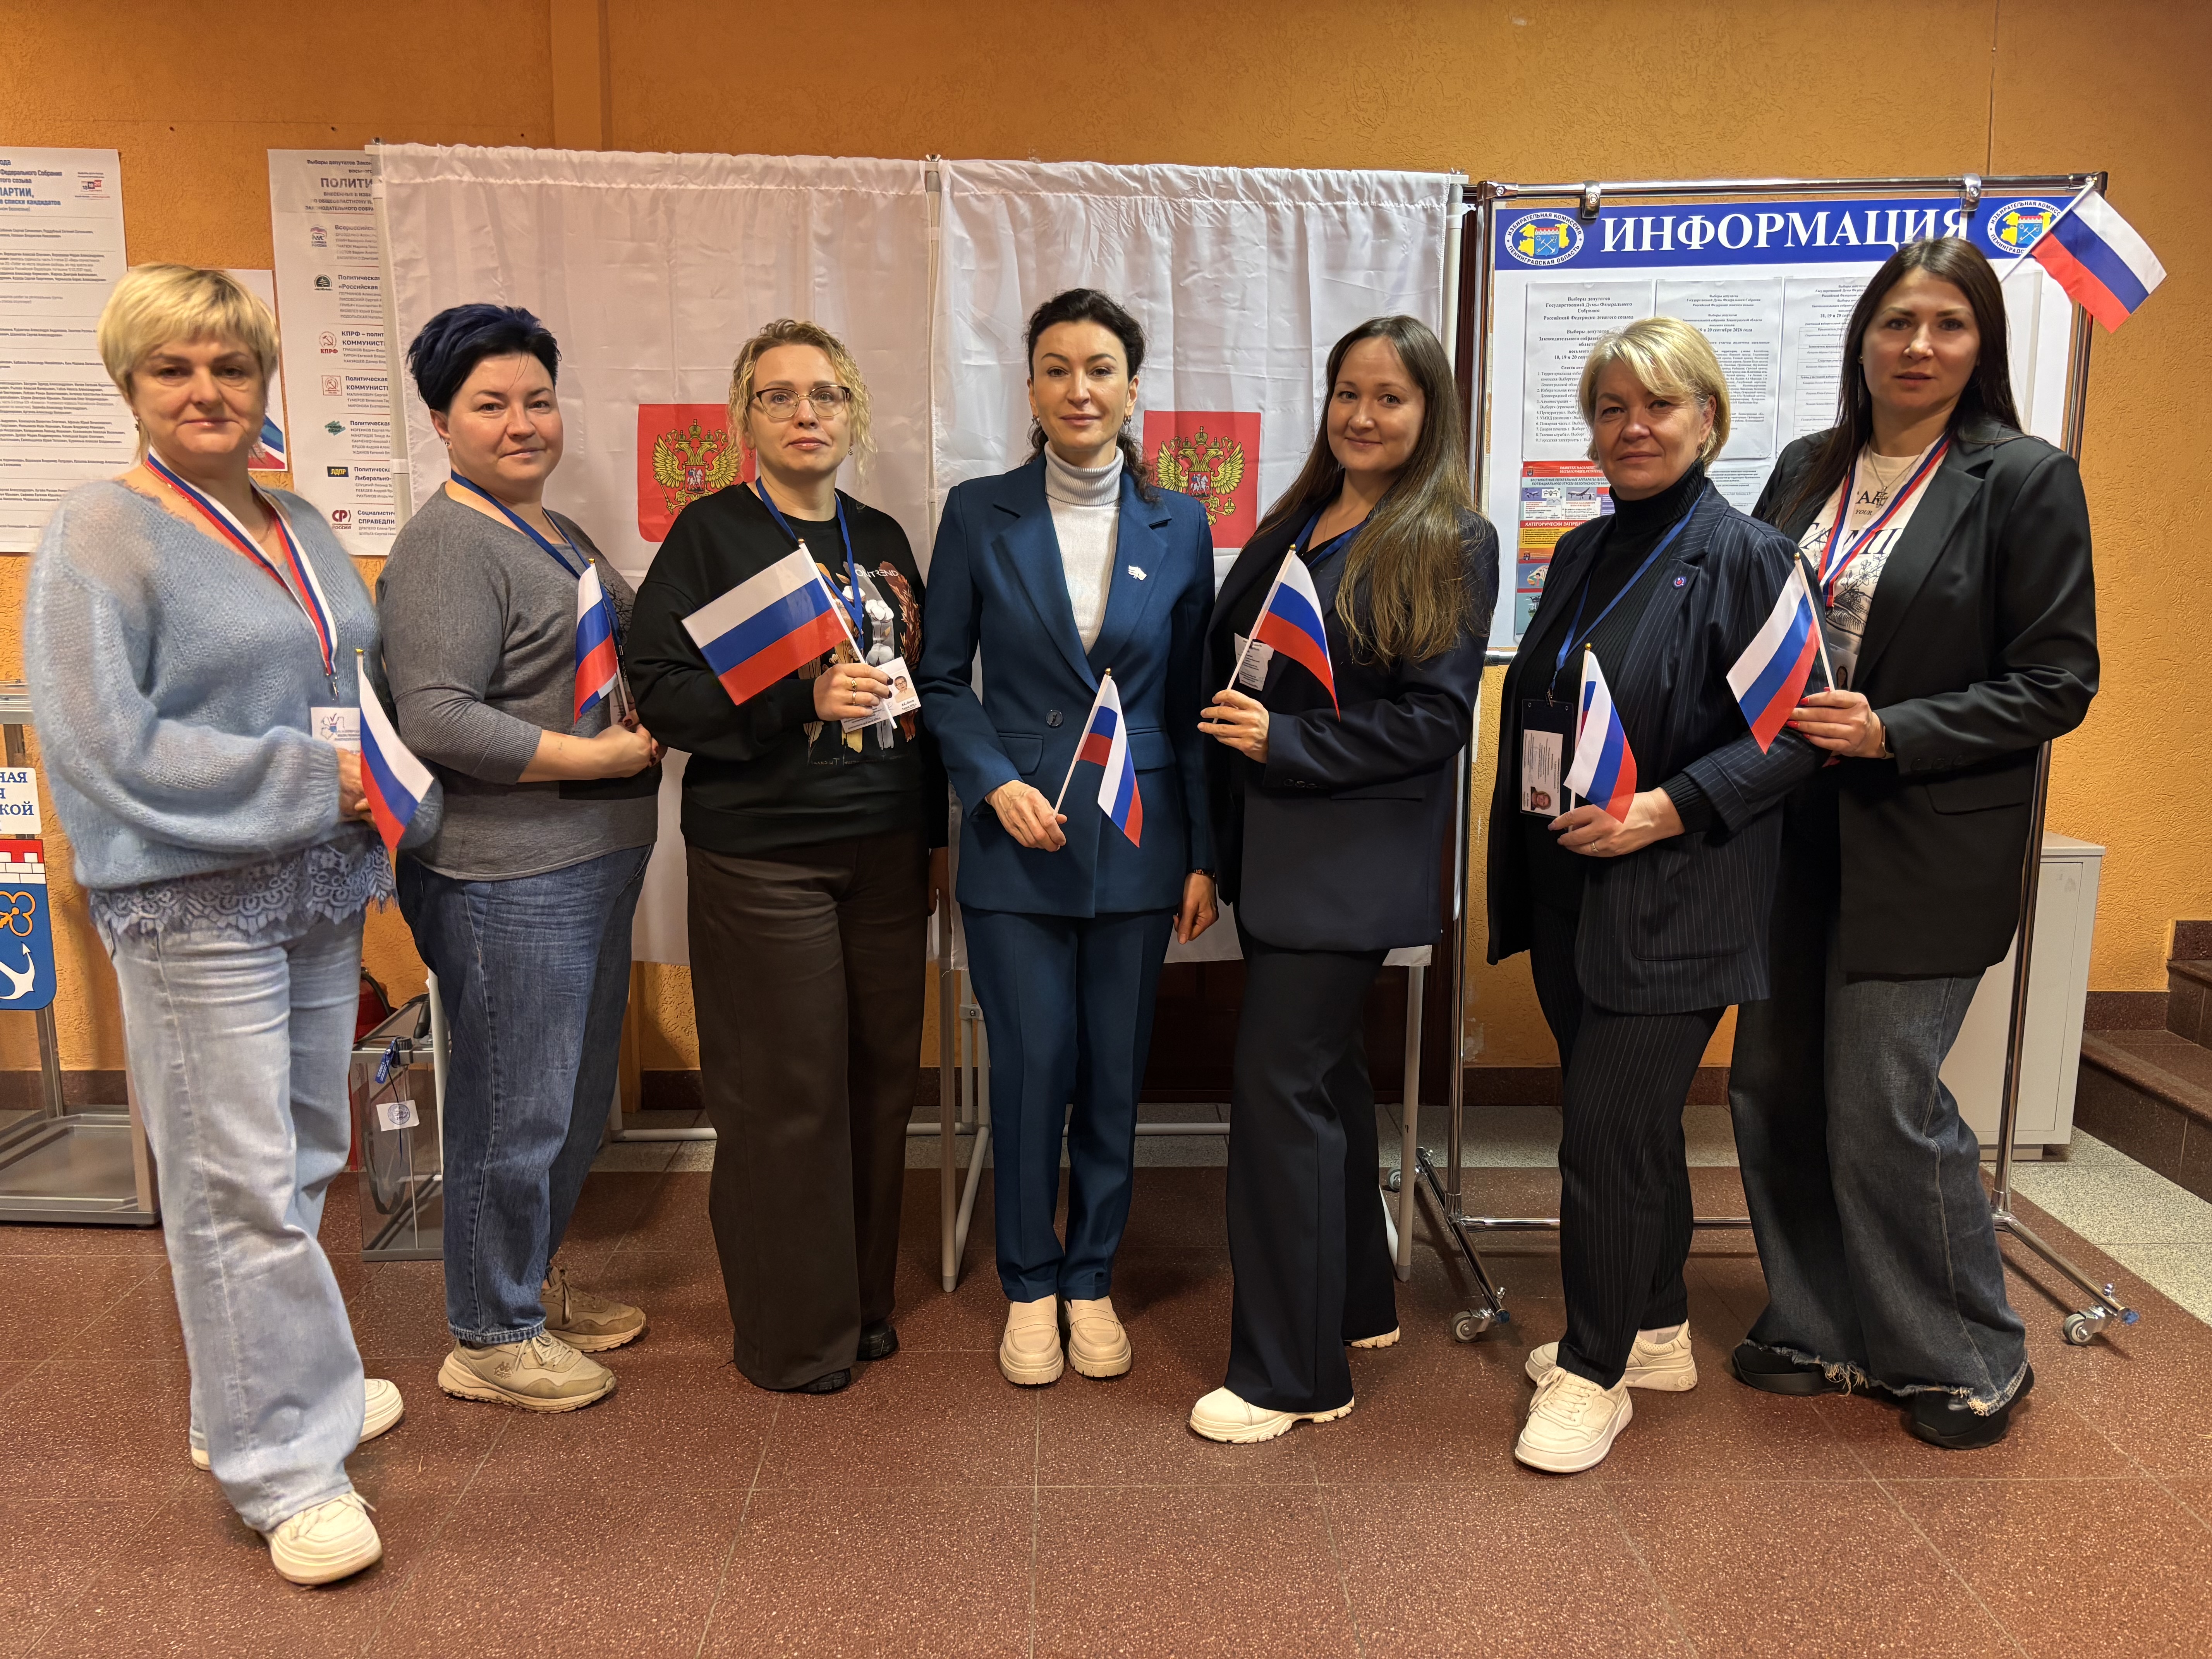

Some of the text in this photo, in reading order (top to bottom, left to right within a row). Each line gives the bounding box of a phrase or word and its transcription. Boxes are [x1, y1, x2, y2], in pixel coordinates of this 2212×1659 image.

[1991, 201, 2061, 224] ИЗБИРАТЕЛЬНАЯ КОМИСС
[1507, 213, 1582, 236] ИЗБИРАТЕЛЬНАЯ КОМИССИЯ
[1601, 209, 1969, 252] ИНФОРМАЦИЯ
[1508, 245, 1580, 265] ЛЕНИНГРАДСКАЯ ОБЛАСТЬ
[1990, 234, 2026, 254] ЛЕНИНГРАДС
